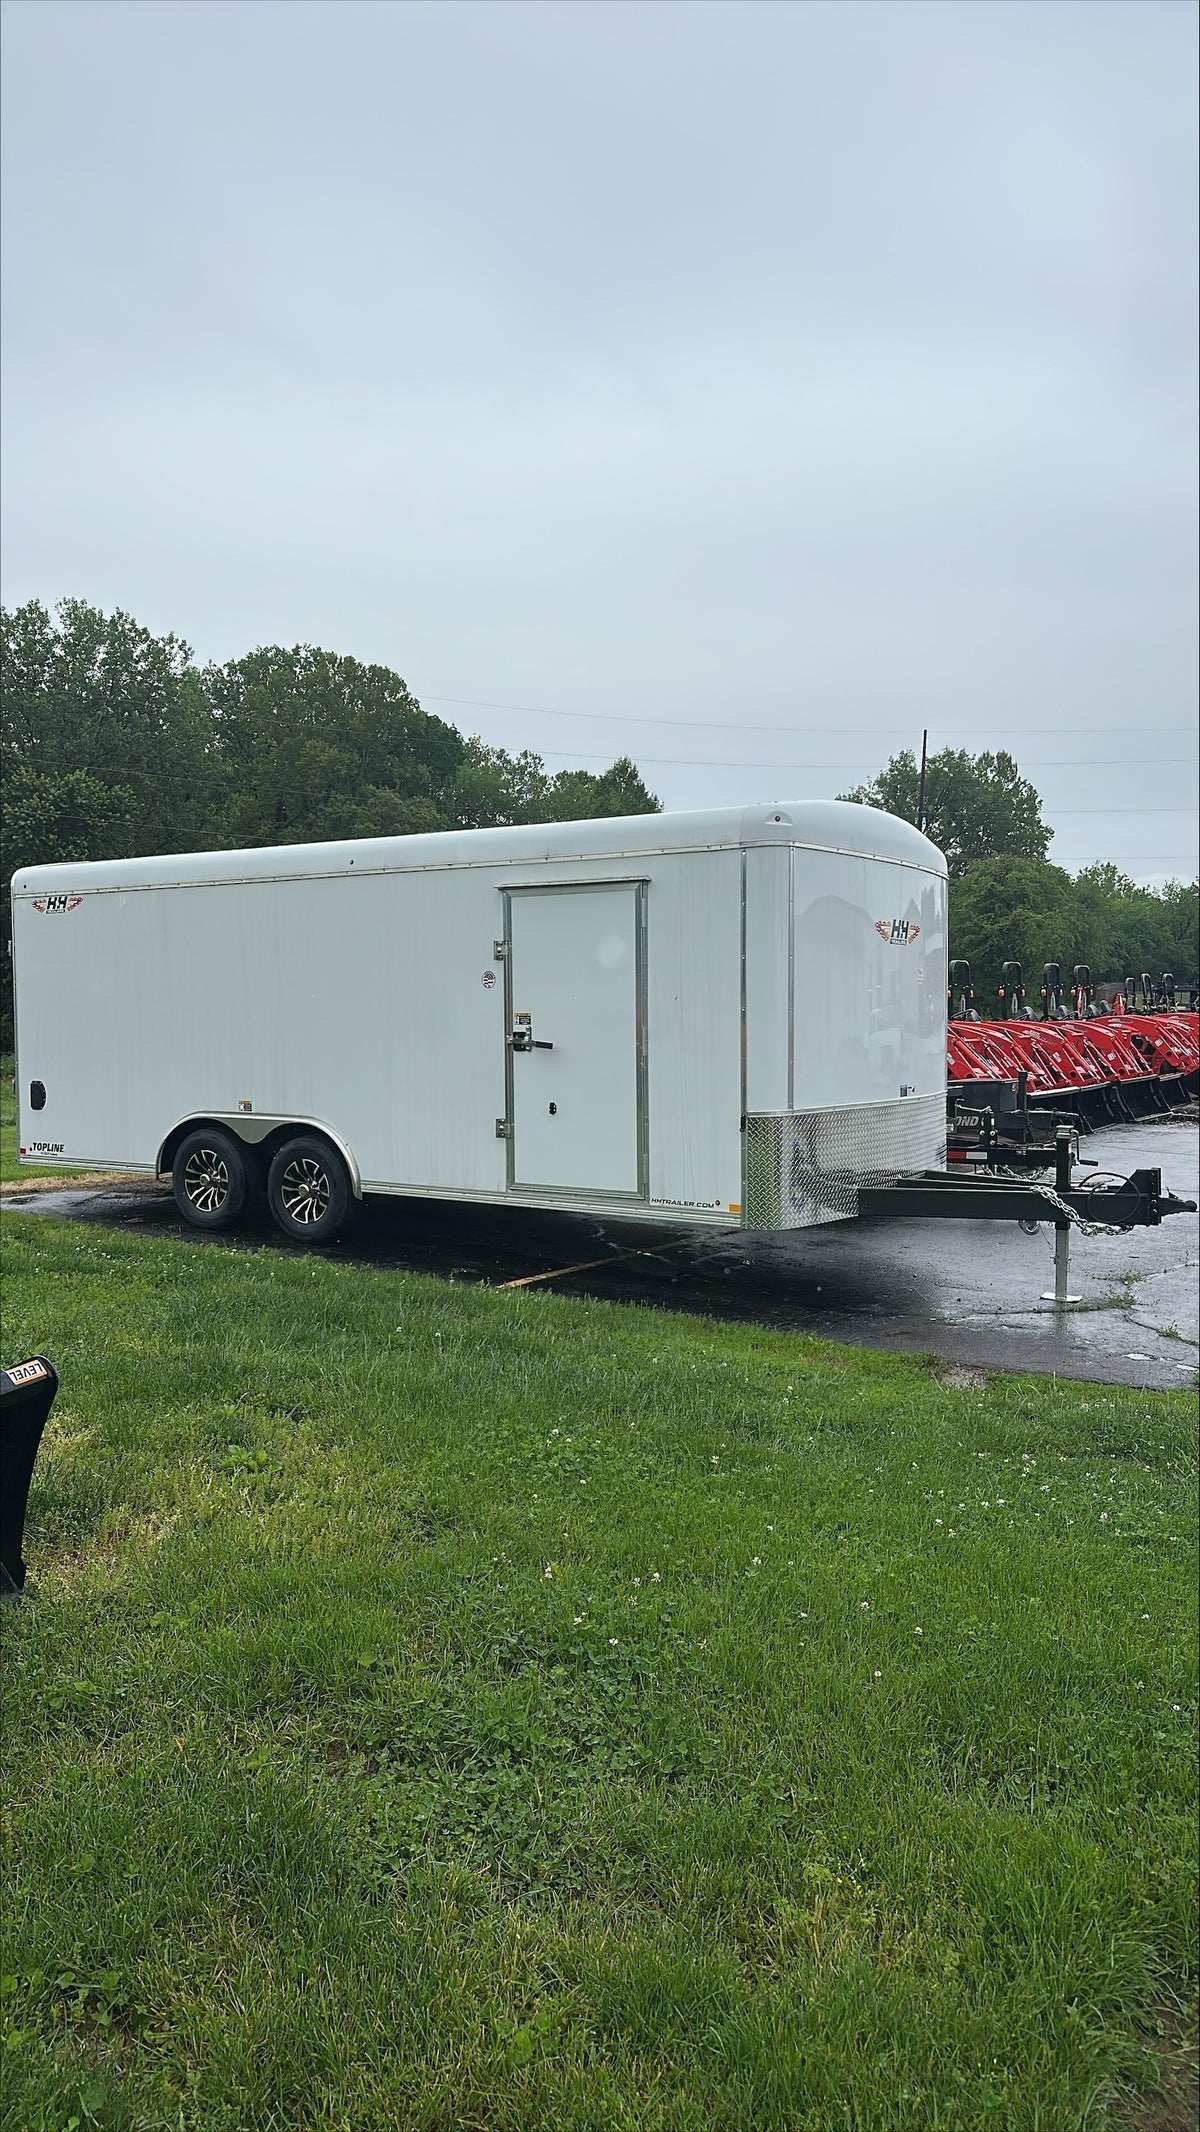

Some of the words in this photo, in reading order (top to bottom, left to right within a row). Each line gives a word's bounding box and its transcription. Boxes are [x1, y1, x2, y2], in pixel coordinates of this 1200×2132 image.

[32, 1142, 65, 1153] TOPLINE
[651, 1198, 714, 1209] HHTRAILERCOM
[9, 1363, 43, 1381] LEVEL
